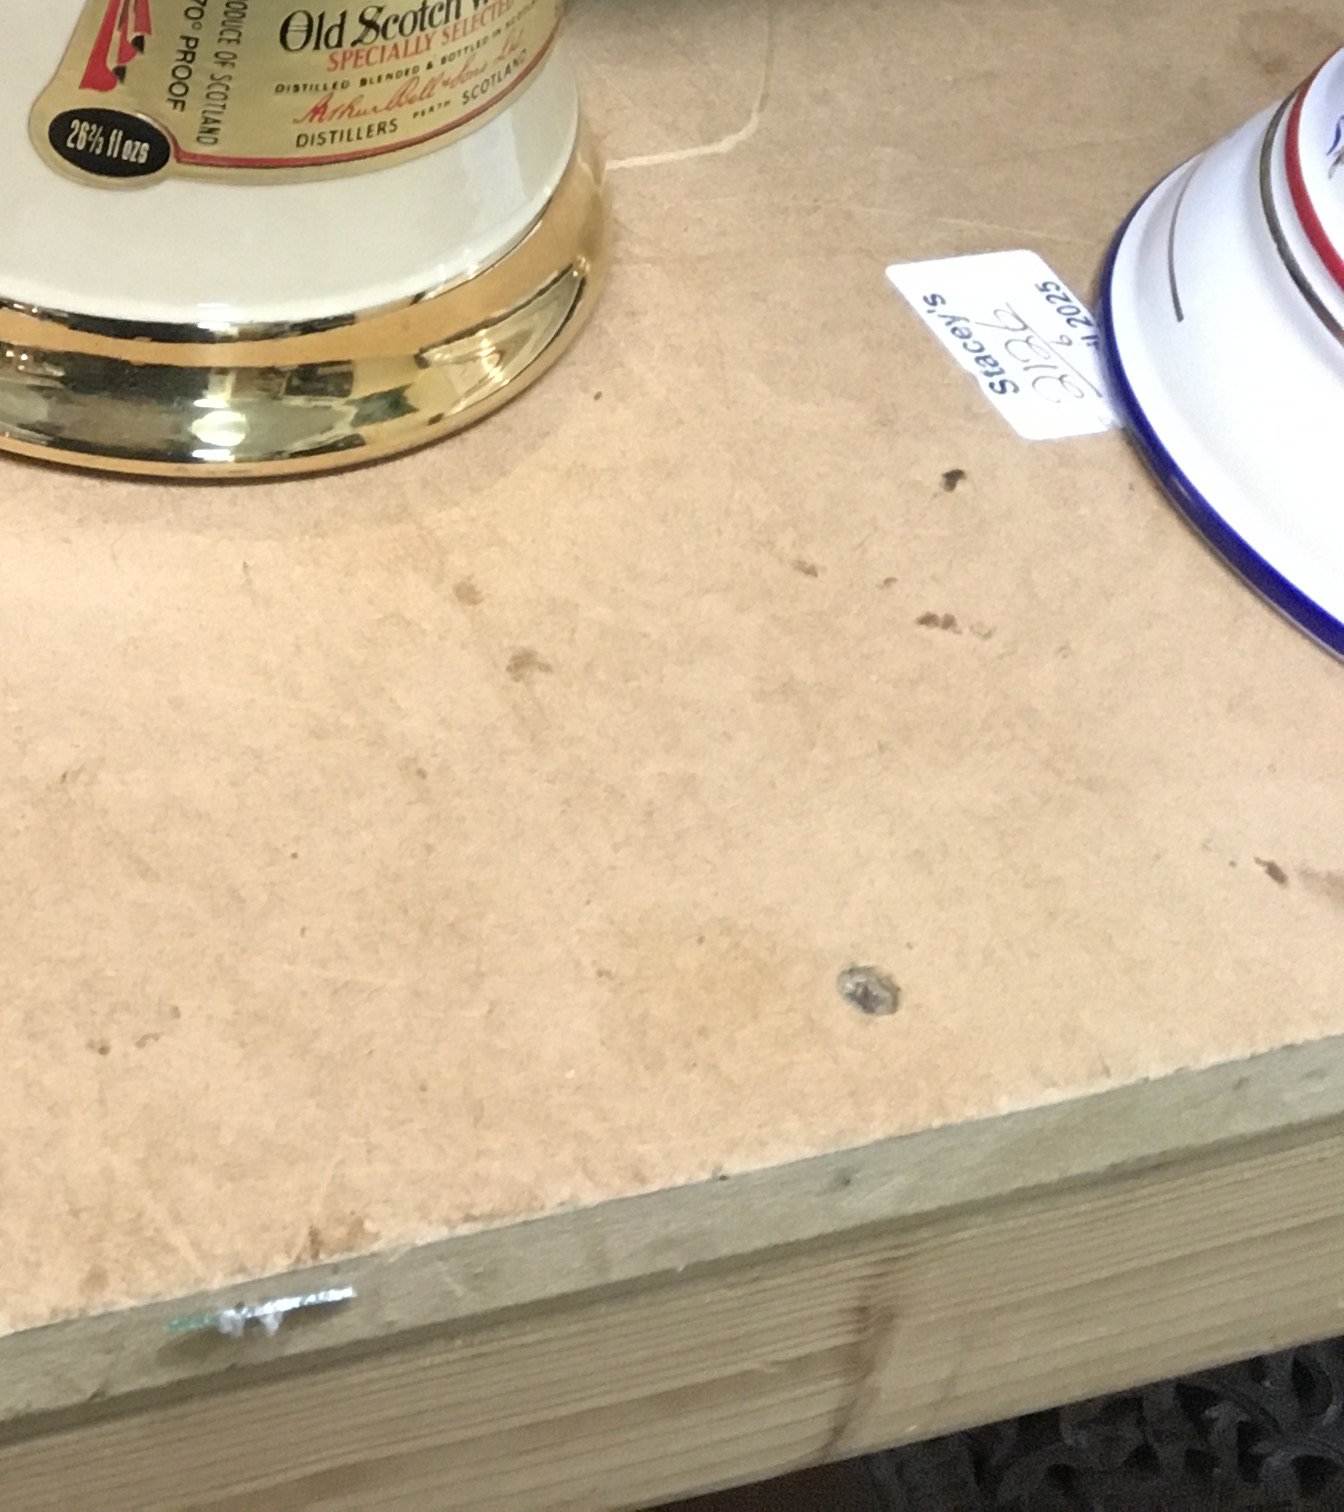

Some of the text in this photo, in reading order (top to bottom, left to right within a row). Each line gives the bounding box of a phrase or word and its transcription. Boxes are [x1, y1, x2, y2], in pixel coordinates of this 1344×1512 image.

[279, 10, 347, 53] Old
[326, 33, 436, 73] SPECIALLY
[166, 34, 200, 114] PROOF
[214, 50, 238, 70] OF
[274, 80, 351, 95] DISTILLED
[359, 64, 420, 89] BLENDED
[440, 36, 490, 67] BOTTLED
[196, 73, 233, 147] SCOTLAND
[295, 48, 528, 149] DISTILLERS PERTH SCOTLAND
[122, 138, 151, 165] ozs
[1034, 280, 1095, 329] 2025
[922, 292, 1021, 396] Stacey's
